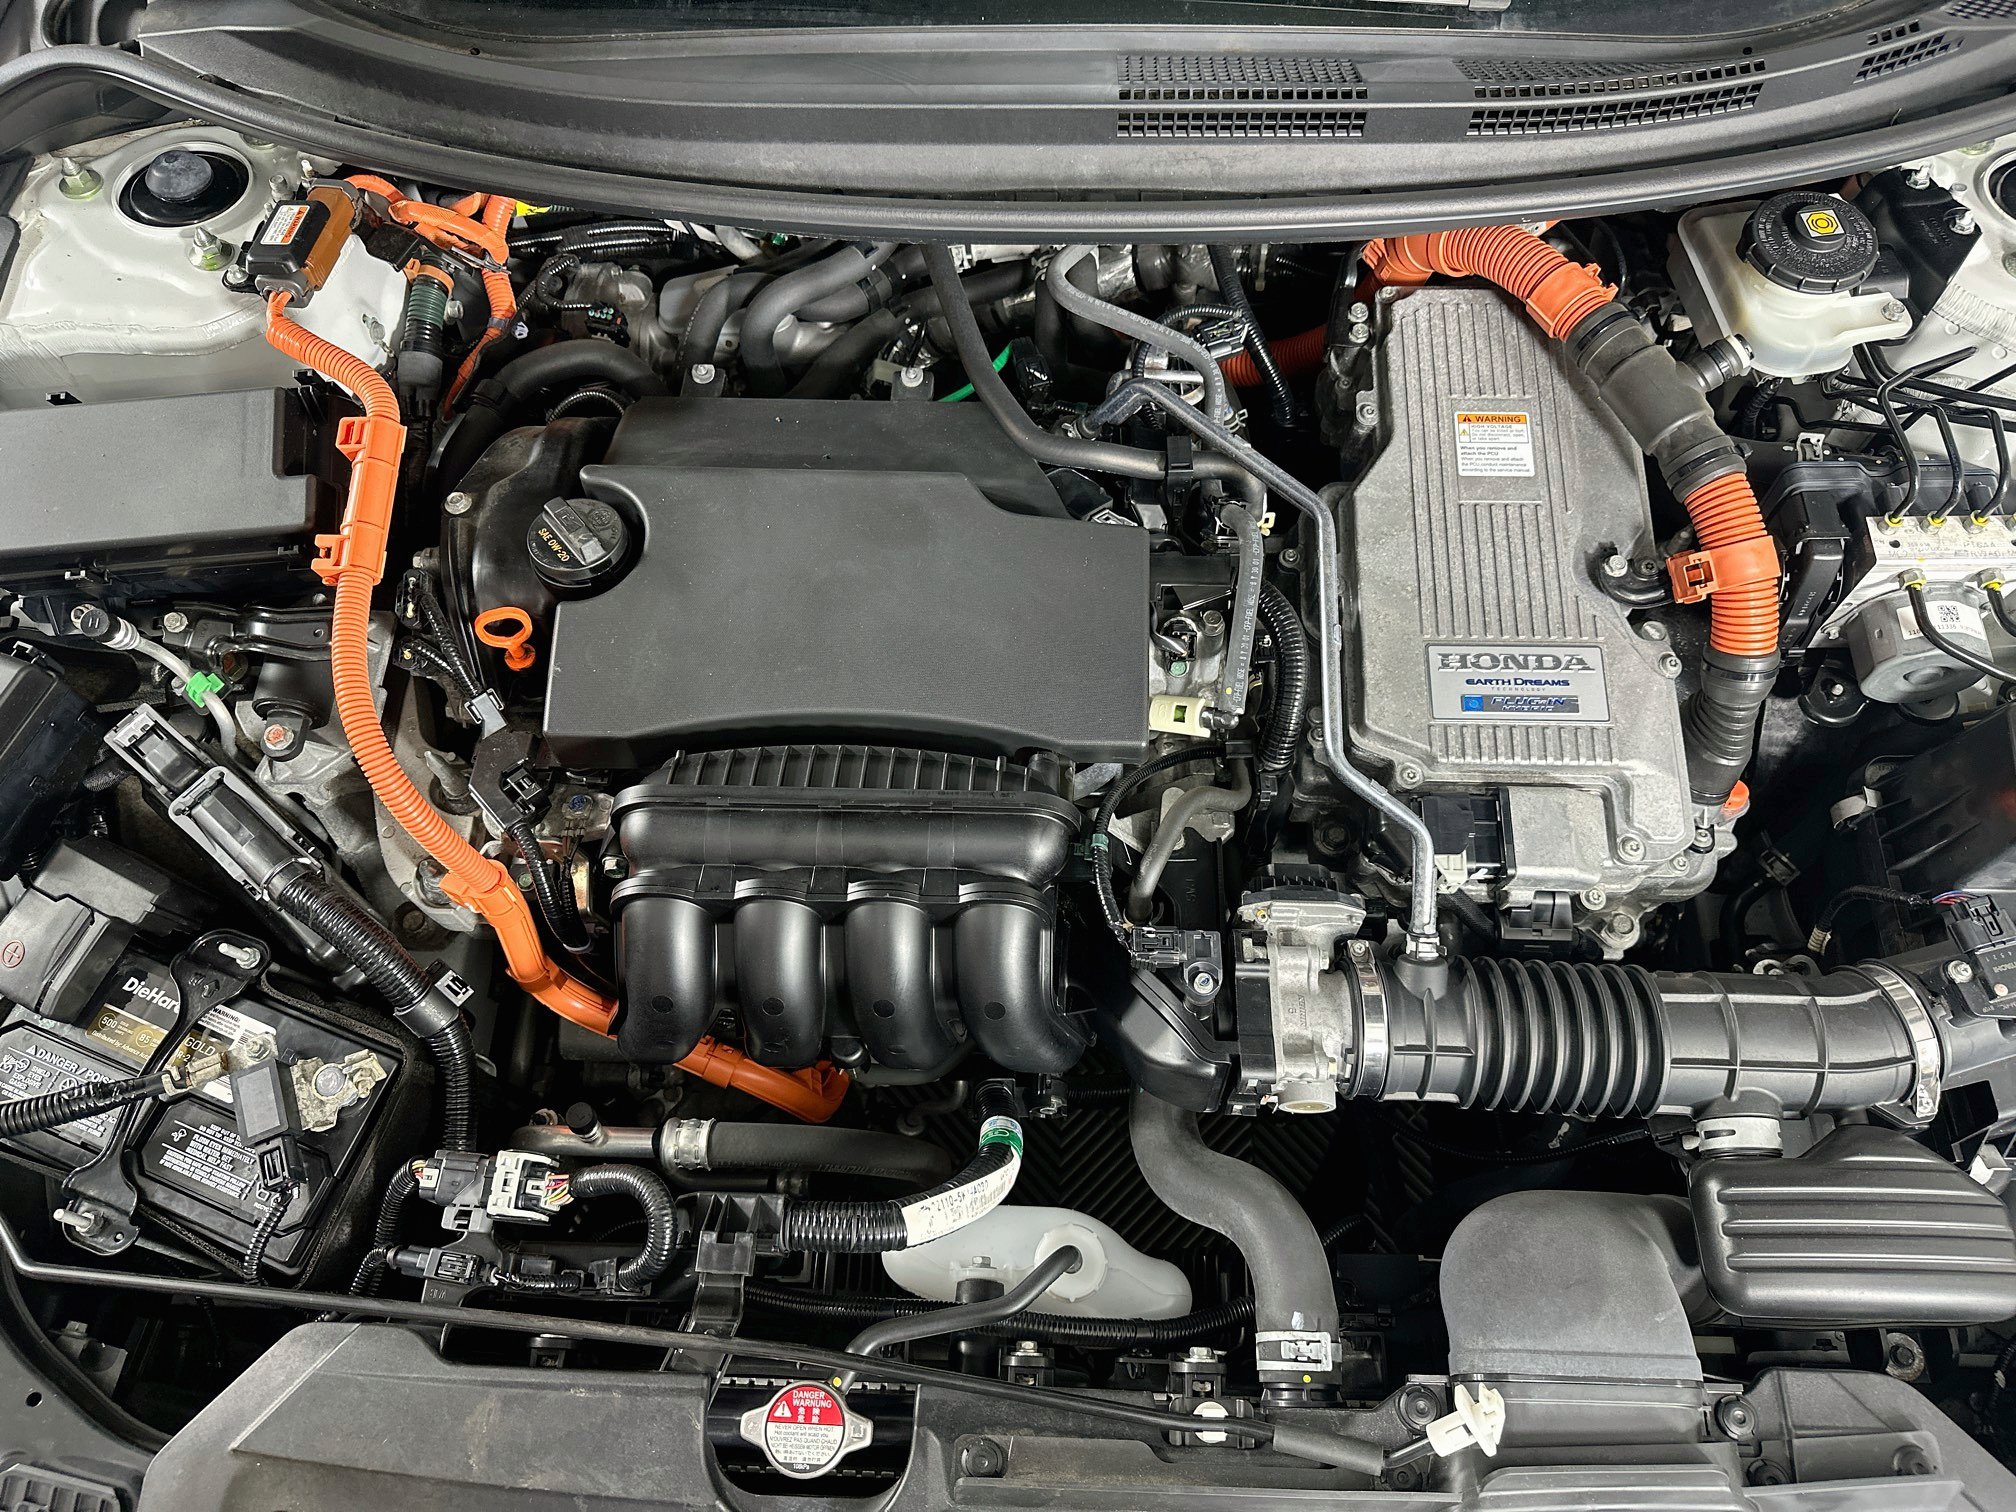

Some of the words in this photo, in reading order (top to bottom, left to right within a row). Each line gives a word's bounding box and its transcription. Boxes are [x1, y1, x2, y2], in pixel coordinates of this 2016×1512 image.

[538, 527, 552, 544] SAE
[548, 540, 570, 562] 0W-20
[1438, 653, 1596, 673] HONDA
[101, 1016, 118, 1029] 500
[138, 1033, 151, 1044] 85
[121, 1043, 140, 1055] Advance
[184, 1036, 216, 1057] GOLD
[35, 1048, 78, 1073] DANGER
[28, 1072, 42, 1081] EYES
[31, 1066, 50, 1077] SHIELD
[8, 1078, 27, 1090] GASES
[12, 1072, 41, 1089] EXPLOSIVE
[189, 1140, 203, 1150] WITH
[221, 1155, 232, 1163] GET
[192, 1134, 209, 1145] FLUSH
[208, 1141, 222, 1151] EYES
[221, 1147, 255, 1166] IMMEDIATELY
[185, 1146, 208, 1160] MEDICAL
[206, 1156, 220, 1166] HELP
[219, 1161, 233, 1171] FAST
[793, 1391, 825, 1399] DANGER
[792, 1399, 832, 1408] WARNUNG
